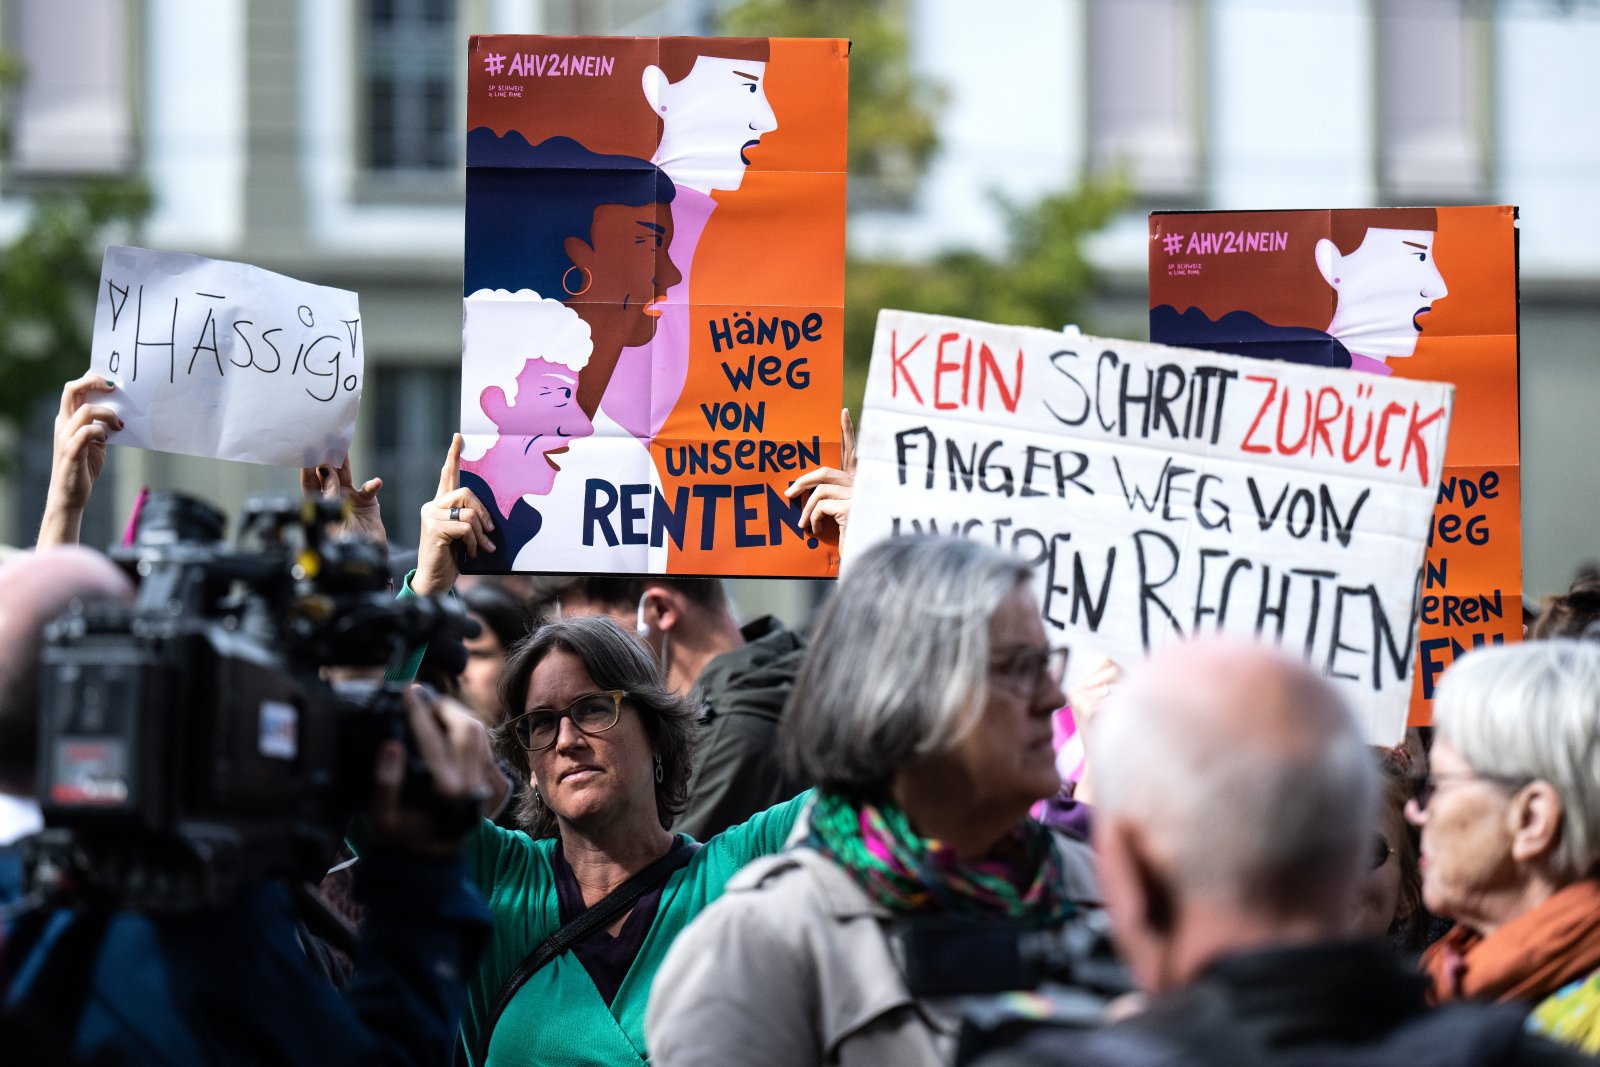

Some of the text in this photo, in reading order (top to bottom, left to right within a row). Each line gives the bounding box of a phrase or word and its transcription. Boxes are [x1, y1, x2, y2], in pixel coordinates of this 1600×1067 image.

[484, 52, 615, 77] #AHV21NEIN
[1162, 230, 1288, 256] #AHV21NEIN
[709, 311, 823, 353] HäNDe
[721, 355, 810, 392] WeG
[700, 401, 766, 433] VON
[891, 330, 1446, 488] KEIN SCHRITT ZURÜCK
[665, 435, 821, 477] UNSeReN
[895, 426, 1371, 548] FINGER WEG VON
[1436, 470, 1500, 509] NDe
[1426, 513, 1490, 548] eG
[1132, 528, 1426, 691] RECHTEN
[1420, 588, 1504, 627] eReN
